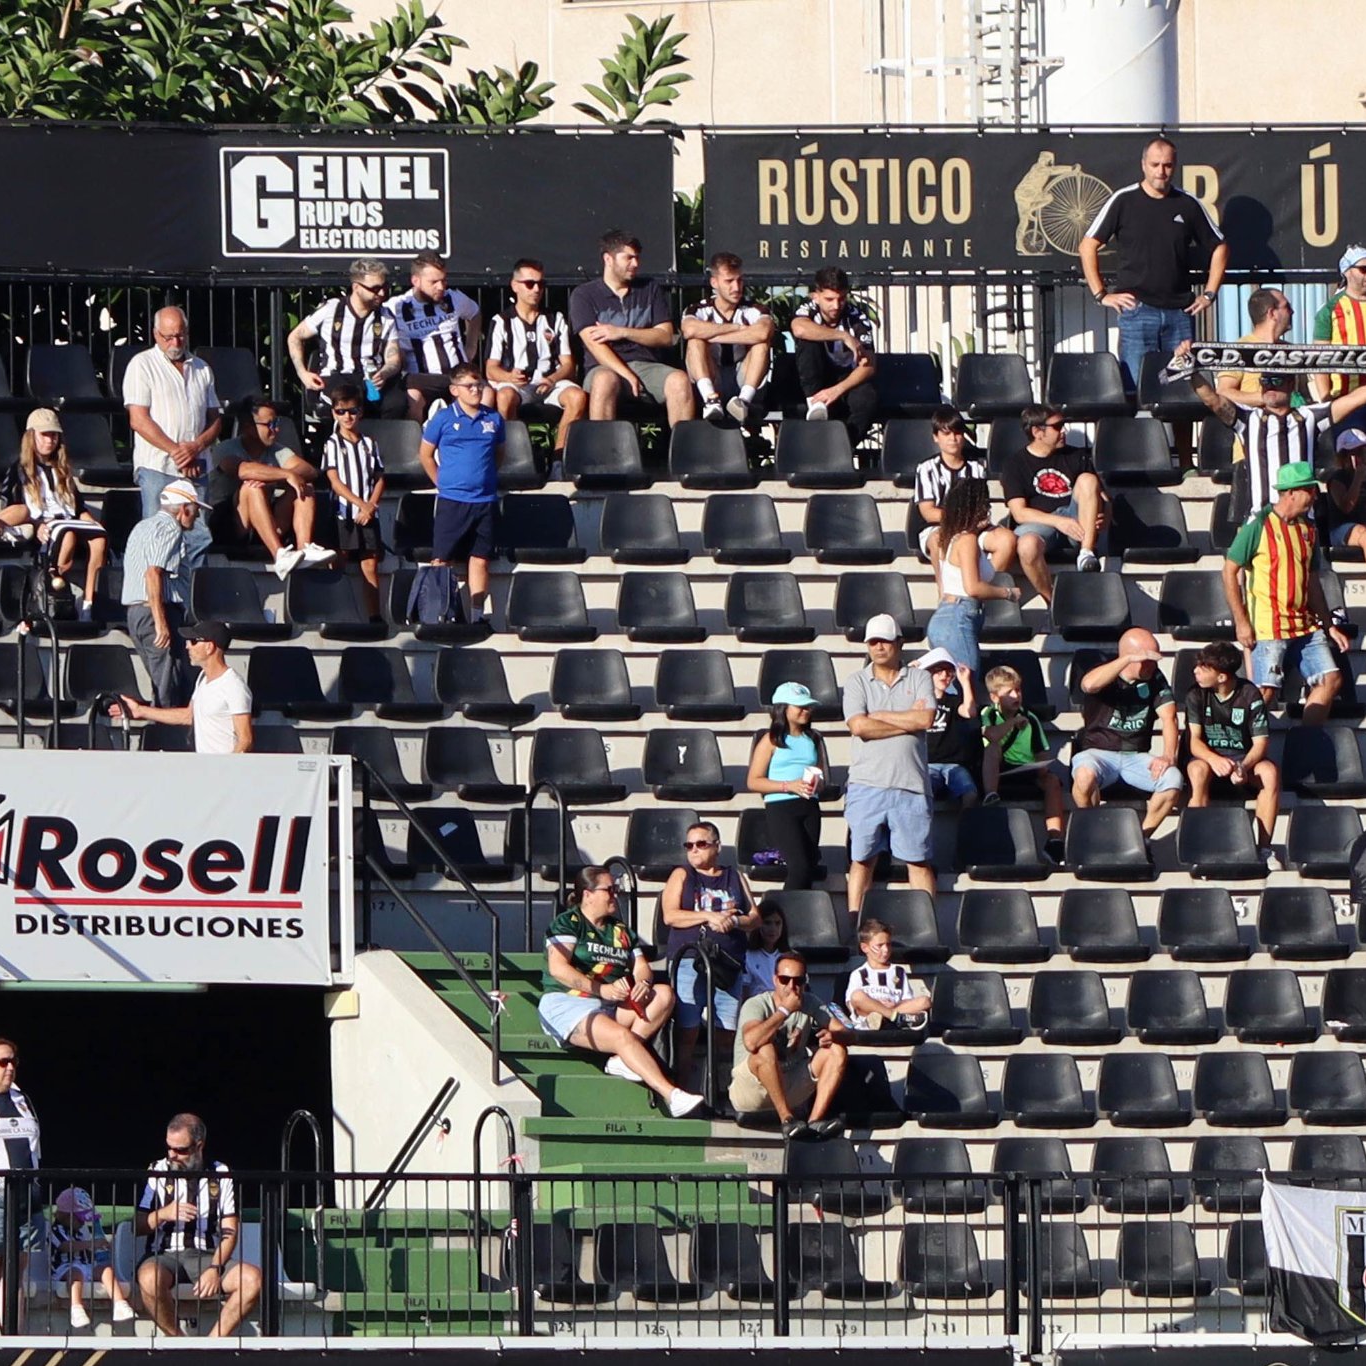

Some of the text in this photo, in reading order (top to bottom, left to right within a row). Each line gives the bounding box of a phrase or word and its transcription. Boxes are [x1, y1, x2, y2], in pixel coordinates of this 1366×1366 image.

[758, 142, 972, 226] RÚSTICO
[299, 228, 440, 251] ELECTROGENOS
[758, 238, 973, 259] RESTAURANTE
[14, 814, 313, 895] Rosell
[15, 913, 305, 939] DISTRIBUCIONES
